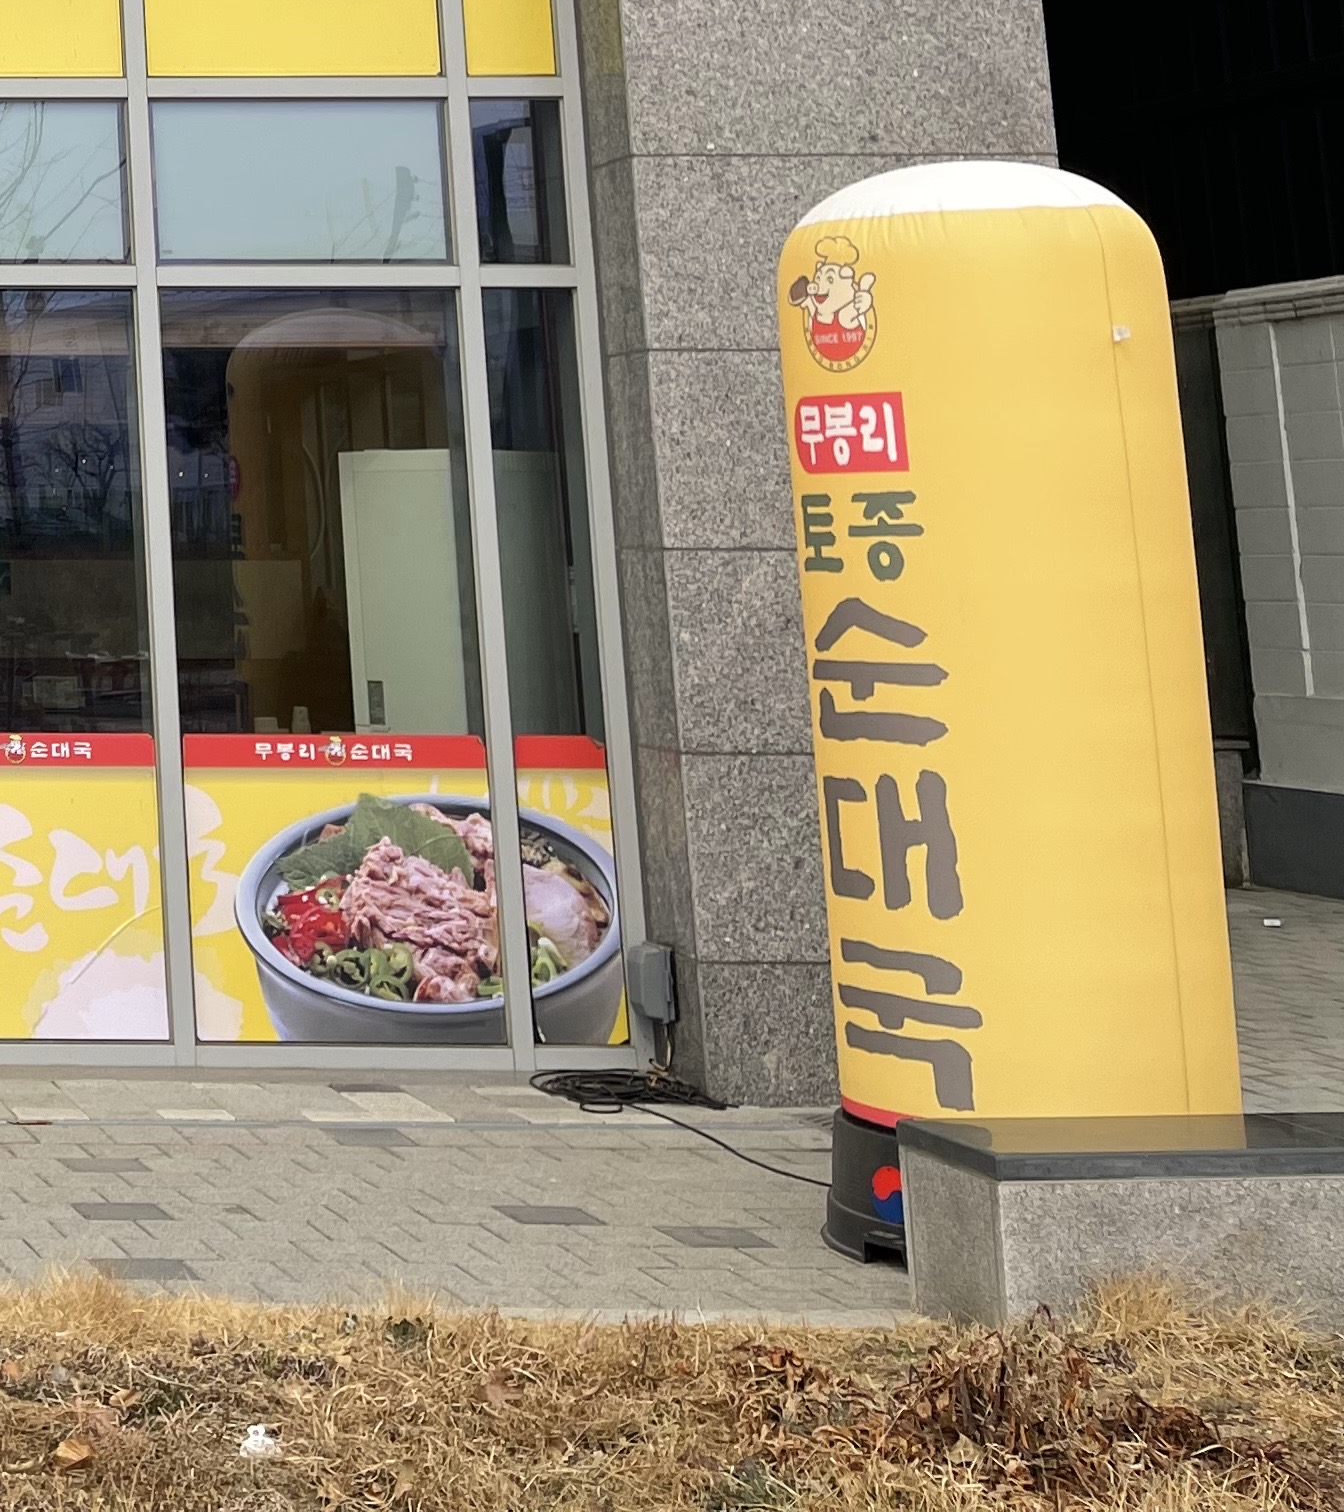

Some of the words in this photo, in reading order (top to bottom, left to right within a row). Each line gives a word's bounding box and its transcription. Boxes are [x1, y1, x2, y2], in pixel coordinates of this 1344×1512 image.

[799, 401, 897, 466] 무봉리
[801, 490, 925, 582] 토종
[30, 741, 92, 759] 순대국
[255, 742, 315, 761] 무봉리
[350, 743, 413, 761] 순대국
[813, 597, 983, 1112] 순대국
